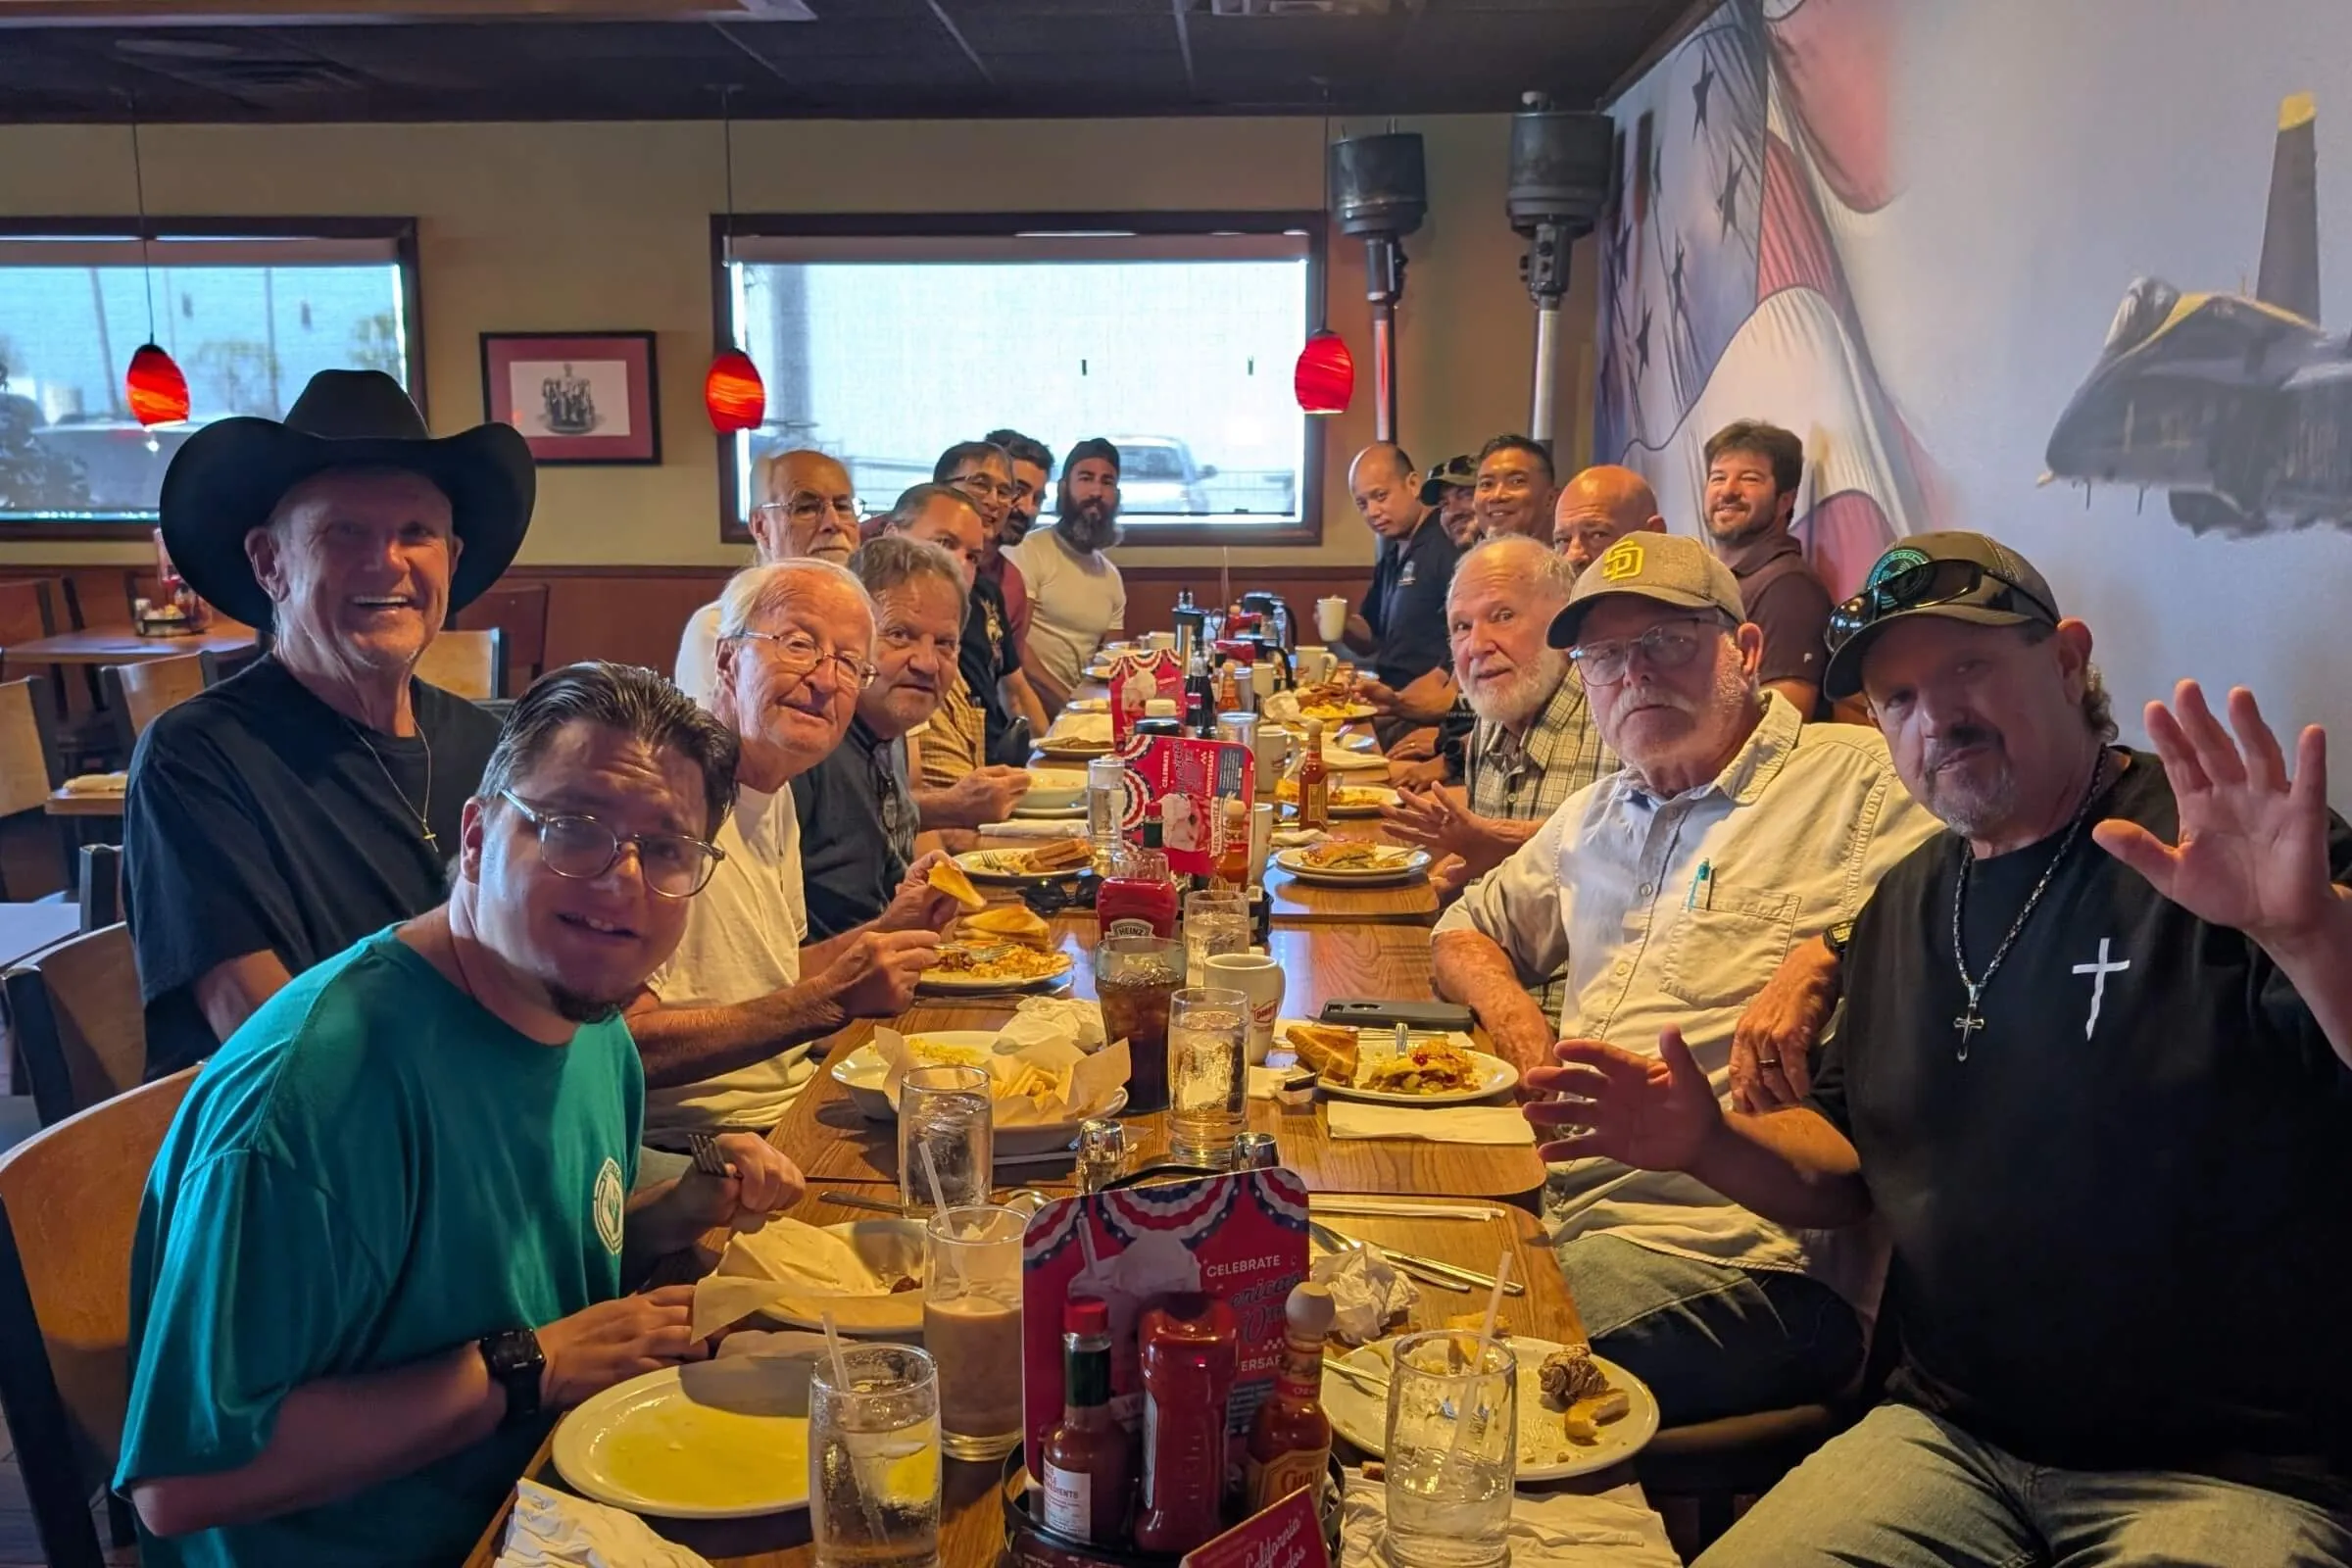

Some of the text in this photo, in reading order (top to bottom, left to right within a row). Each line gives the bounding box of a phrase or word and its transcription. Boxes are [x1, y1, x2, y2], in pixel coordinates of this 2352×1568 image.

[1205, 750, 1214, 797] ANNIVERSARY
[1118, 925, 1147, 936] HEINZ
[1206, 1254, 1281, 1278] CELEBRATE
